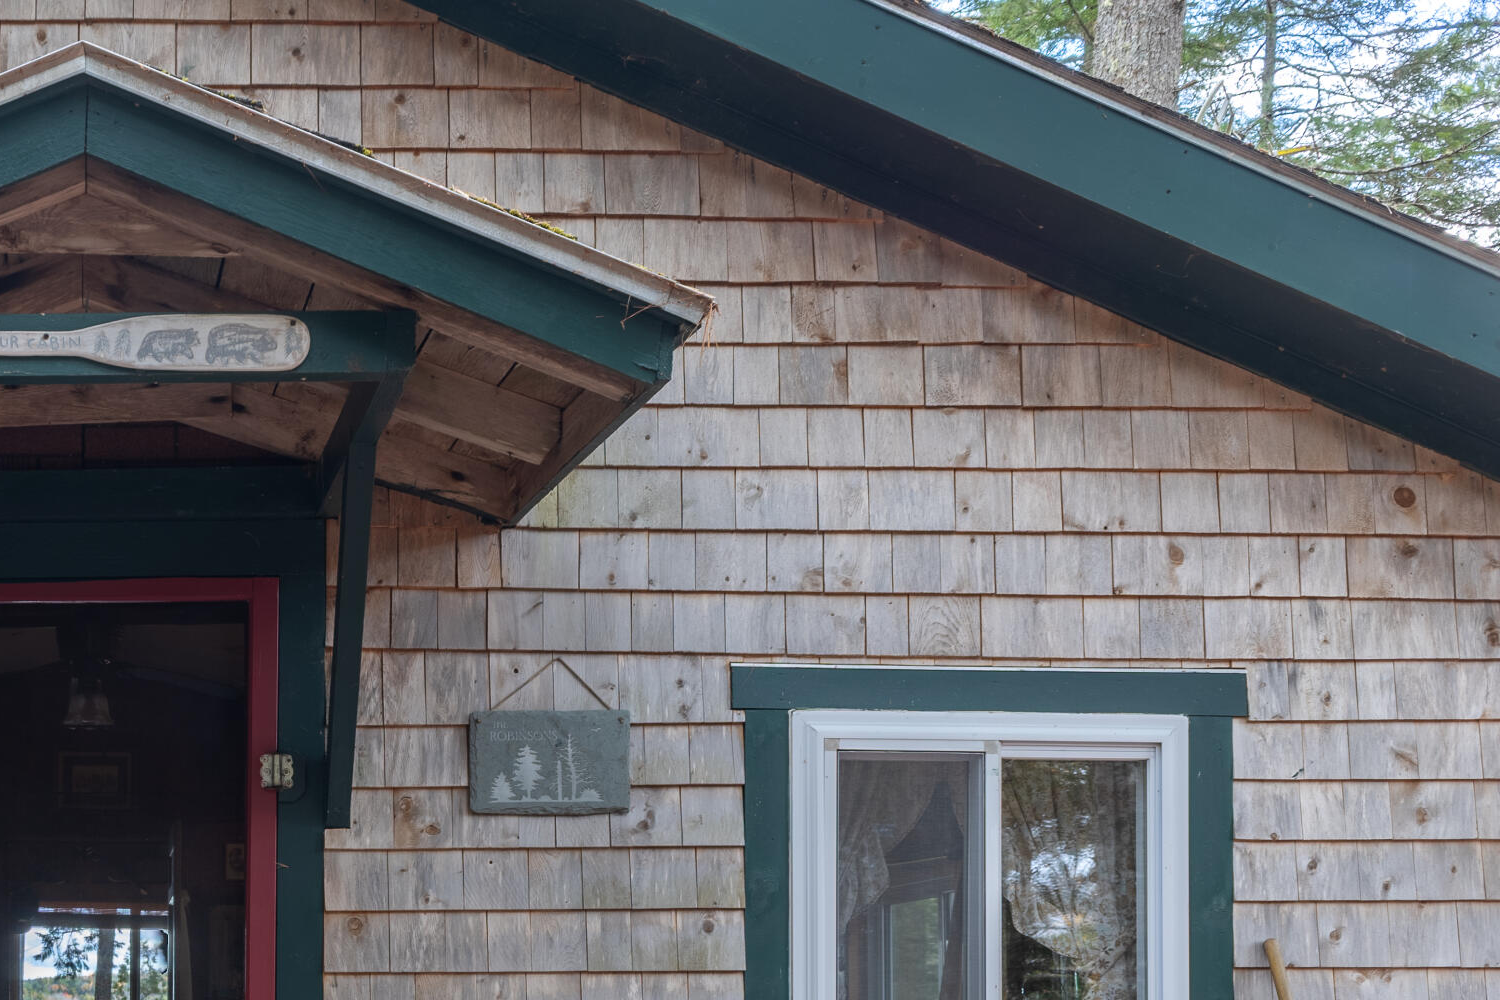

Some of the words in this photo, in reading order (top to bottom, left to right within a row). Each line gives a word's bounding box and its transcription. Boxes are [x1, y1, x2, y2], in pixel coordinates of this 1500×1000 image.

[27, 335, 82, 350] CABIN
[492, 719, 509, 729] THE
[490, 729, 558, 741] ROBINSONS
